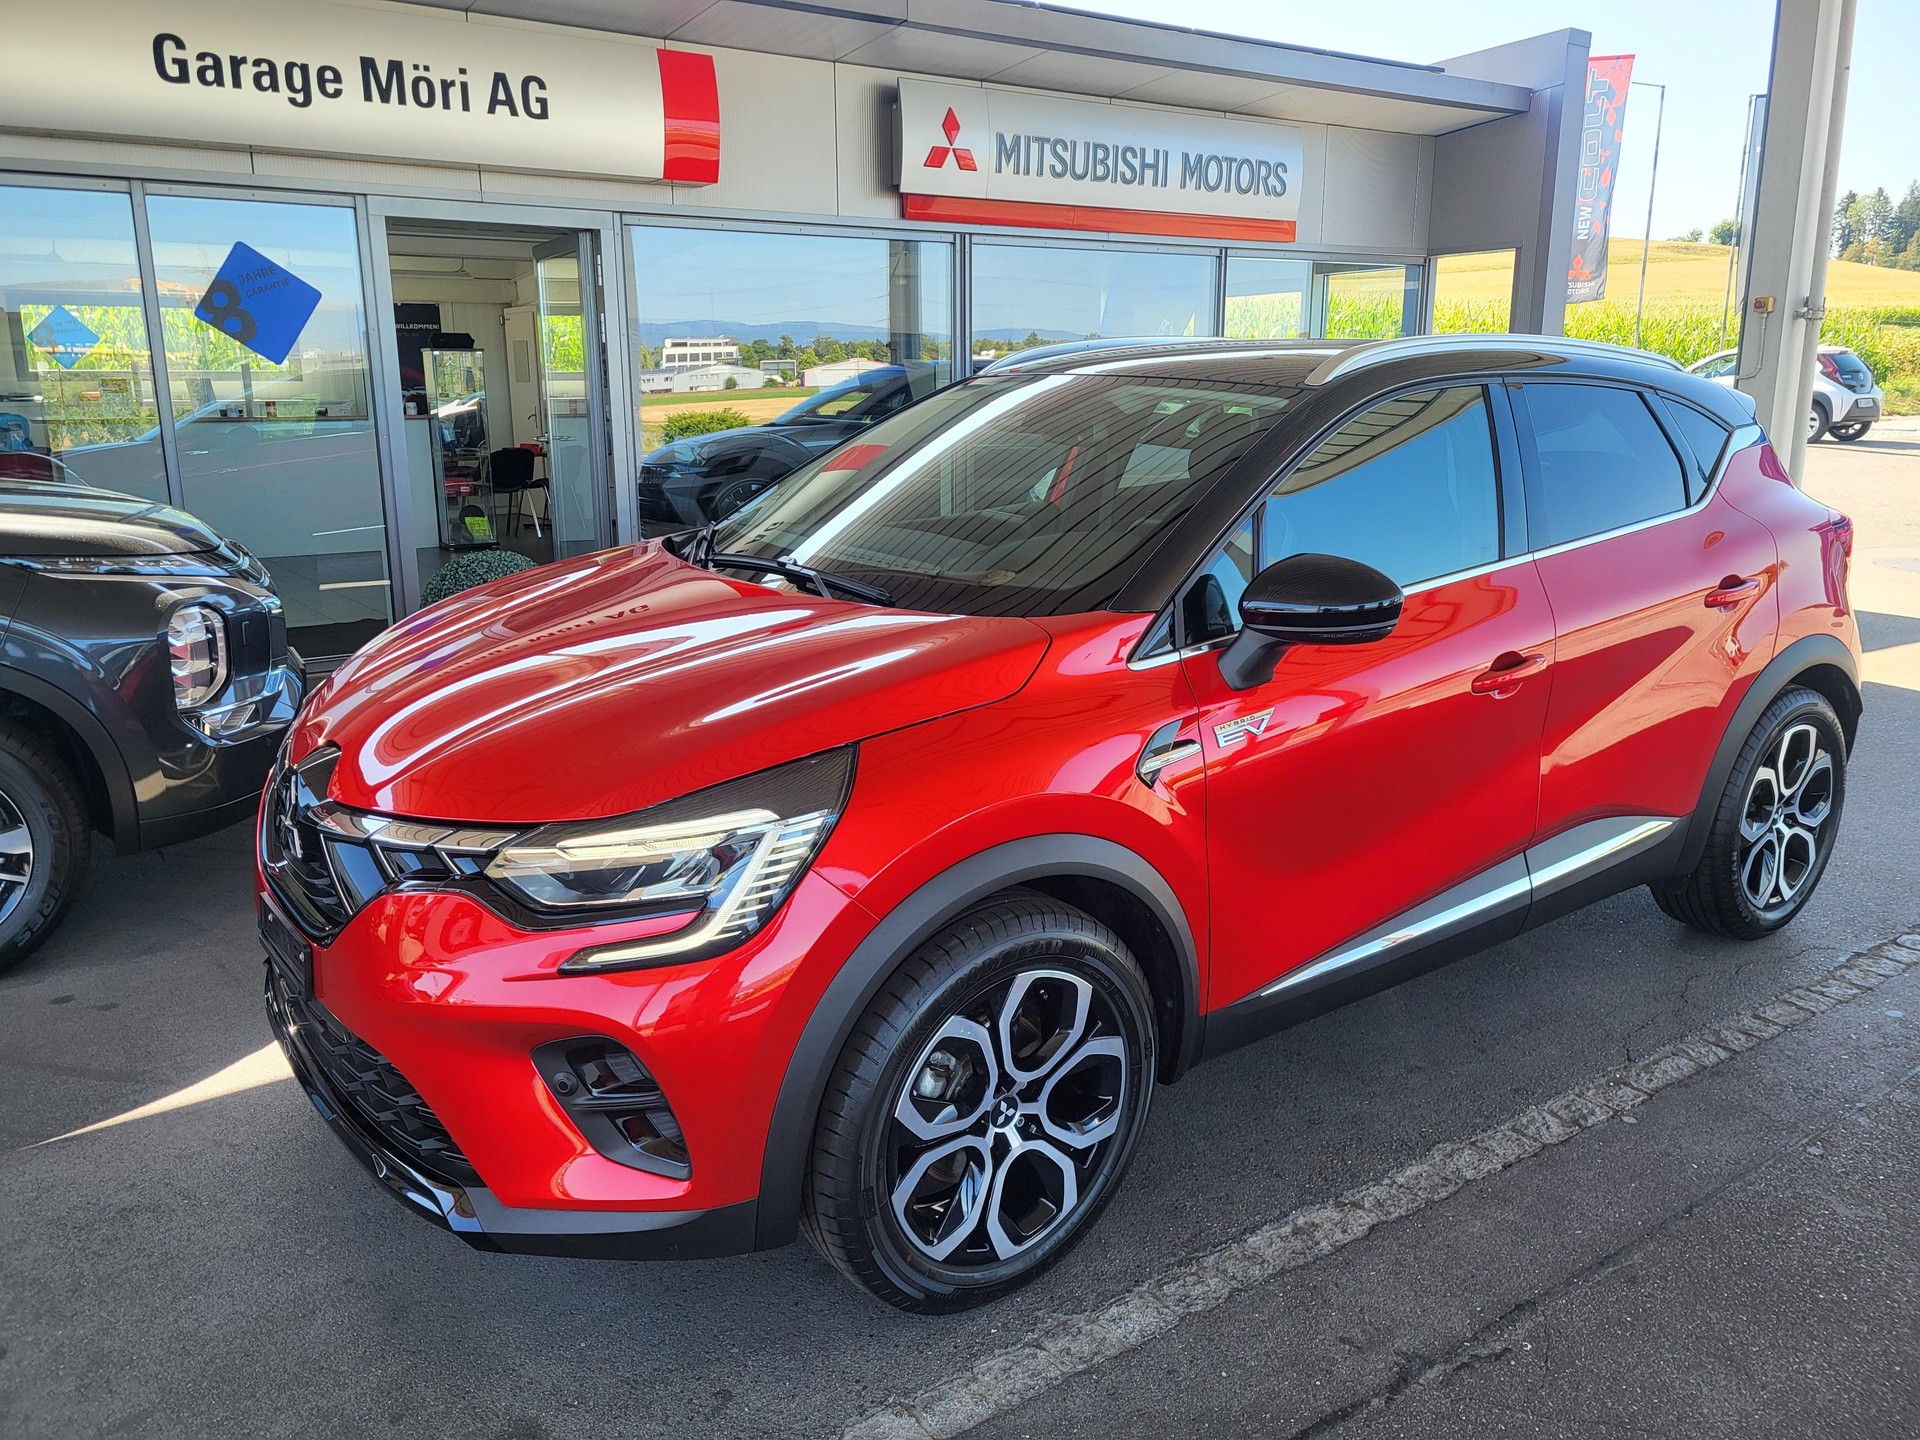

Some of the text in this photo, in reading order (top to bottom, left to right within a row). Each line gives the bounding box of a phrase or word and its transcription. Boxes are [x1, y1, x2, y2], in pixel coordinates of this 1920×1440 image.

[152, 32, 549, 120] Garage Möri AG
[994, 131, 1288, 198] MITSUBISHI MOTORS
[1576, 67, 1610, 240] NEW COLT
[238, 265, 278, 285] JAHRE
[245, 277, 291, 298] GARANTIE
[200, 278, 258, 345] 8
[1219, 715, 1256, 730] HYBRID
